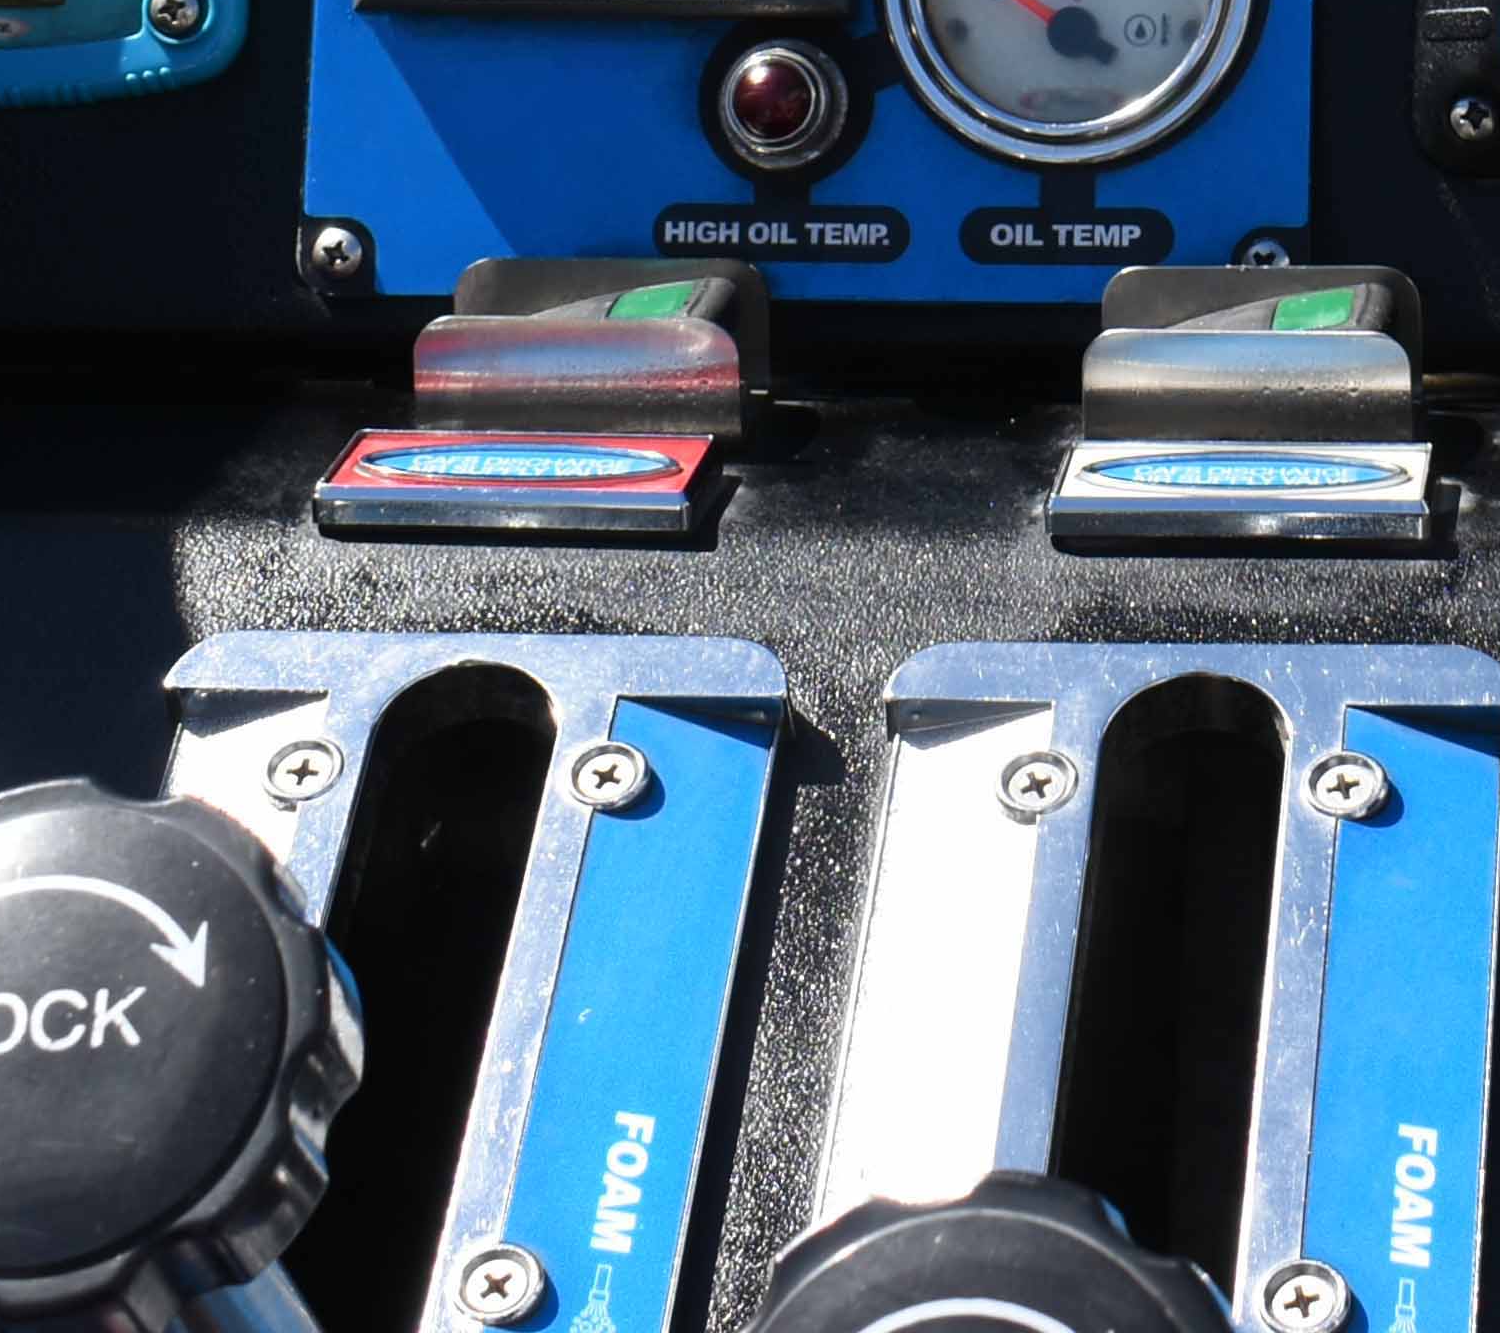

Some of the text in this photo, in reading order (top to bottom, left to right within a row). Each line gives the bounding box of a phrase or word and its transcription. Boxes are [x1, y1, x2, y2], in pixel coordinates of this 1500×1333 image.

[664, 221, 889, 245] HIGH OIL TEMP.
[990, 224, 1141, 247] OIL TEMP
[590, 1111, 655, 1253] FOAM
[1387, 1124, 1438, 1266] FOAM
